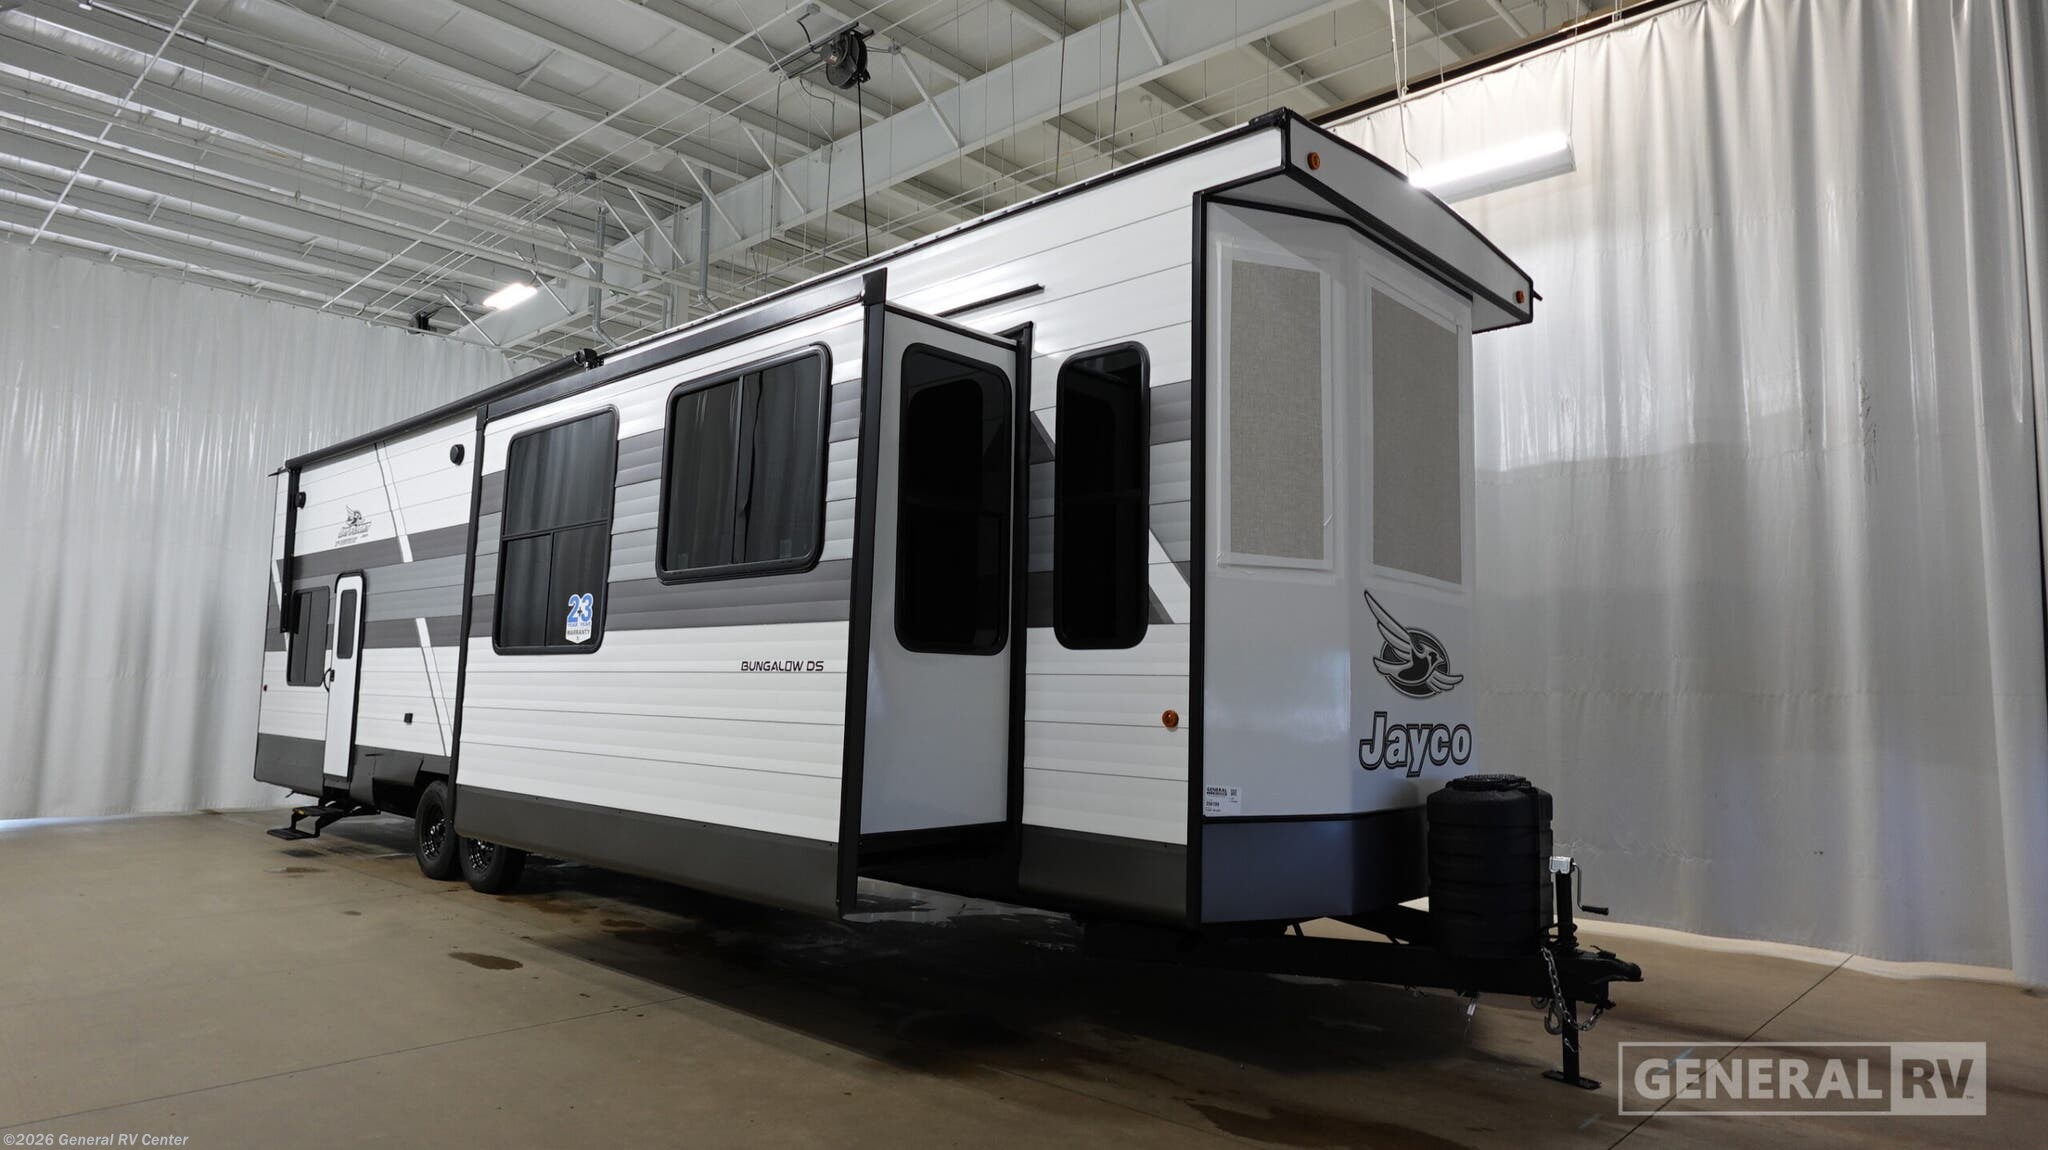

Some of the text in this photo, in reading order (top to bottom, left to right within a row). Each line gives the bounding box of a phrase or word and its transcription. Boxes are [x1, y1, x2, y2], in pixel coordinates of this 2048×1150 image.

[741, 660, 824, 672] BUNGALOW DS
[1359, 711, 1472, 777] Jayco
